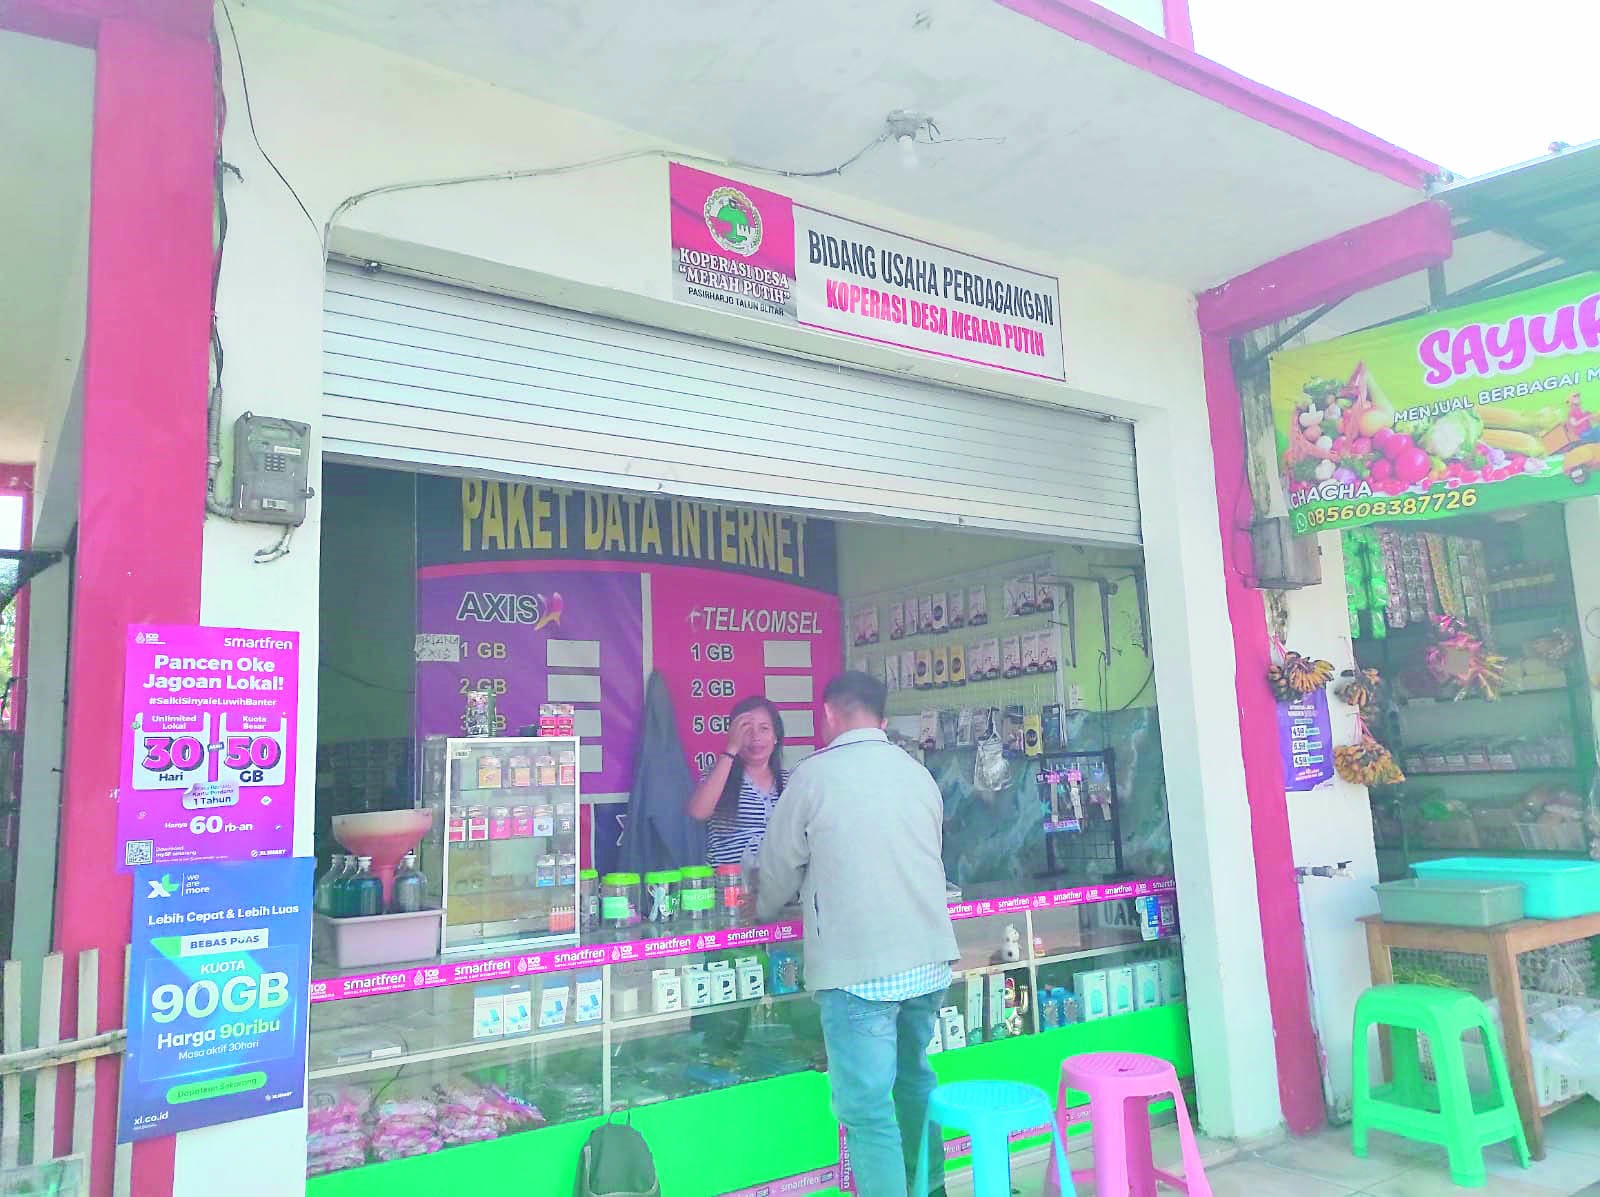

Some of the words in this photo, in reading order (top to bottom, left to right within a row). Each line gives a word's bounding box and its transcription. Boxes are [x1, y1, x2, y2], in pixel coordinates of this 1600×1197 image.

[680, 248, 752, 278] KOPERASI
[755, 265, 789, 288] DESA
[808, 229, 877, 280] BIDANG
[881, 250, 939, 296] USAHA
[943, 266, 1054, 326] PERDAGANGAN
[688, 287, 734, 304] PASIRHARJO
[736, 298, 758, 311] TALUN
[760, 304, 784, 316] BLITAR
[826, 279, 907, 326] KOPERASI
[911, 301, 948, 336] DESA
[951, 310, 1002, 347] MERAH
[1004, 325, 1045, 357] PUTIH
[1393, 395, 1474, 424] MENJUAL
[1478, 371, 1581, 405] BERBAGAI
[1290, 481, 1373, 508] CHACHA
[1307, 488, 1477, 527] 085608387726
[462, 479, 573, 552] PAKET
[585, 488, 663, 555] DATA
[671, 499, 807, 577] INTERNET
[457, 592, 538, 624] AXIS
[704, 606, 823, 634] TELKOMSEL
[223, 636, 294, 650] smartfren
[461, 641, 469, 658] 1
[477, 642, 507, 659] GB
[691, 642, 701, 662] 1
[706, 643, 735, 662] GB
[154, 654, 233, 671] Pancen
[236, 657, 276, 673] Oke
[143, 673, 222, 693] Jagoan
[226, 675, 285, 691] Lokal!
[460, 678, 470, 694] 2
[477, 678, 507, 695] GB
[691, 679, 704, 698] 2
[708, 679, 736, 698] GB
[151, 714, 197, 723] Unlimited
[242, 715, 267, 723] Kuota
[692, 715, 705, 734] 5
[141, 736, 205, 772] 30
[223, 735, 282, 770] 50
[694, 751, 717, 771] 10
[158, 771, 184, 782] Hari
[239, 770, 264, 783] GB
[200, 796, 231, 806] Tahun
[165, 822, 188, 830] Hanya
[190, 815, 223, 835] 60
[224, 822, 253, 833] rb-an
[186, 880, 200, 888] are
[186, 887, 210, 895] more
[148, 911, 185, 926] Lebih
[186, 909, 225, 925] Cepat
[226, 909, 236, 919] &
[238, 905, 270, 918] Lebih
[271, 904, 300, 916] Luas
[947, 903, 972, 914] artfren
[998, 897, 1030, 908] smartfren
[190, 937, 228, 950] BEBAS
[200, 959, 247, 975] KUOTA
[343, 973, 406, 991] smartfren
[454, 960, 511, 976] smartfren
[554, 949, 605, 963] smartfren
[644, 937, 691, 952] smartfren
[727, 928, 769, 941] smartfren
[151, 971, 289, 1024] 90GB
[157, 1028, 216, 1050] Harga
[219, 1019, 281, 1040] 90ribu
[178, 1049, 205, 1061] Masa
[206, 1044, 227, 1057] aktif
[228, 1039, 260, 1052] 30hari
[133, 1110, 169, 1125] xl.co.id
[781, 1174, 819, 1193] smartfren
